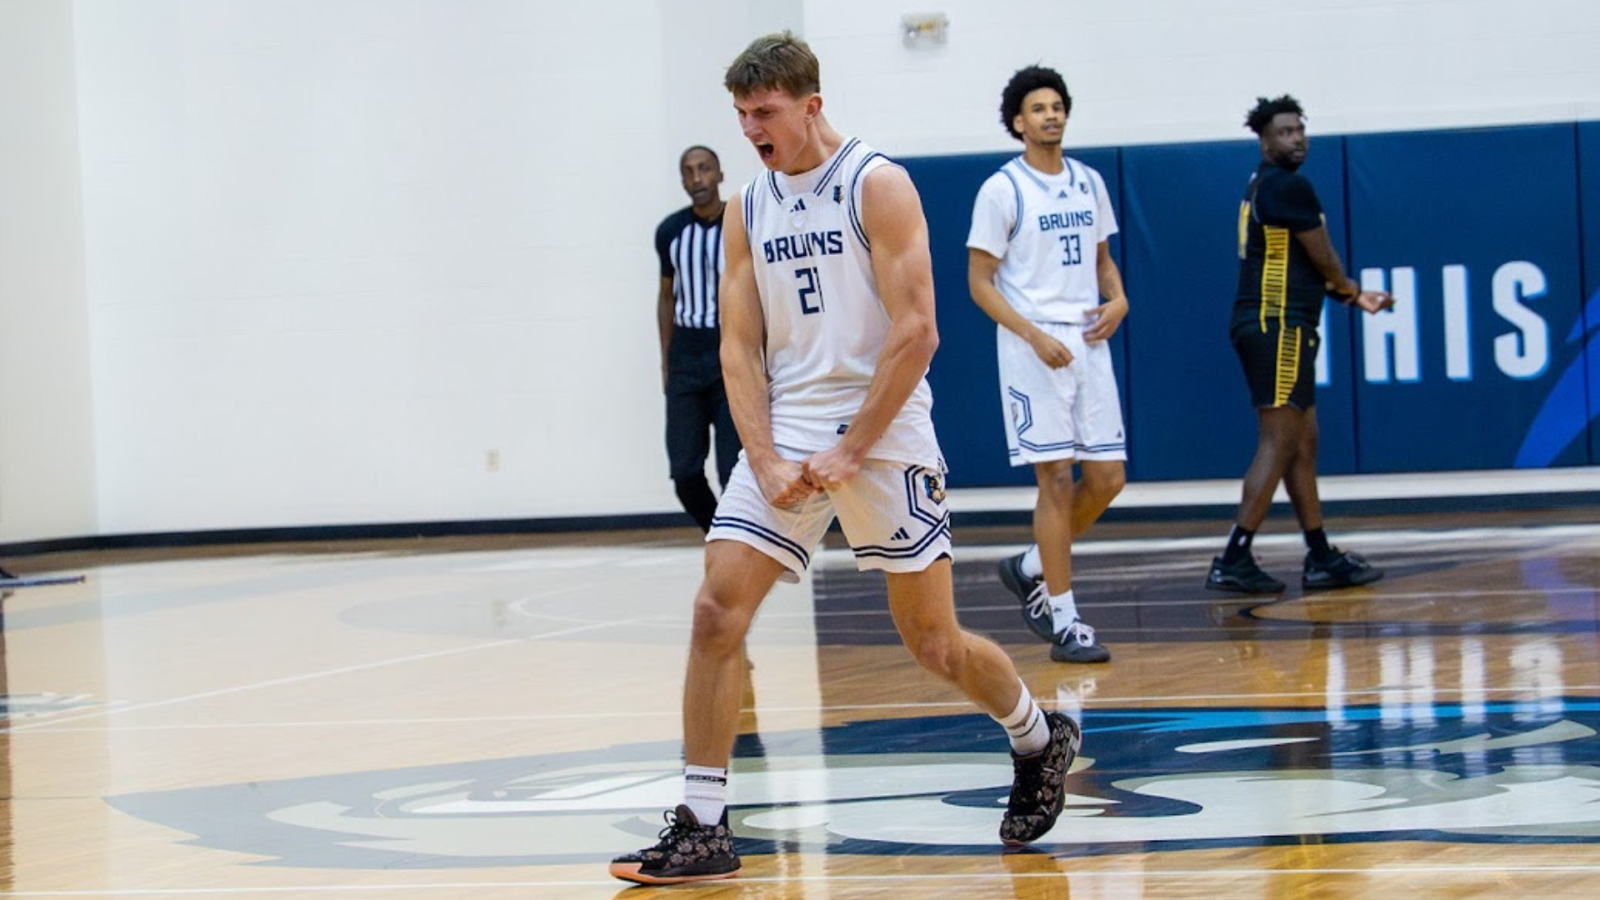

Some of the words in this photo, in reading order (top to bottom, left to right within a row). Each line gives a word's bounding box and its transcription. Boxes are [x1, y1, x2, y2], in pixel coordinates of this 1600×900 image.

[1038, 209, 1094, 232] BRUINS
[763, 230, 843, 264] BRUINS
[1059, 234, 1082, 266] 33
[1315, 260, 1549, 387] HIS
